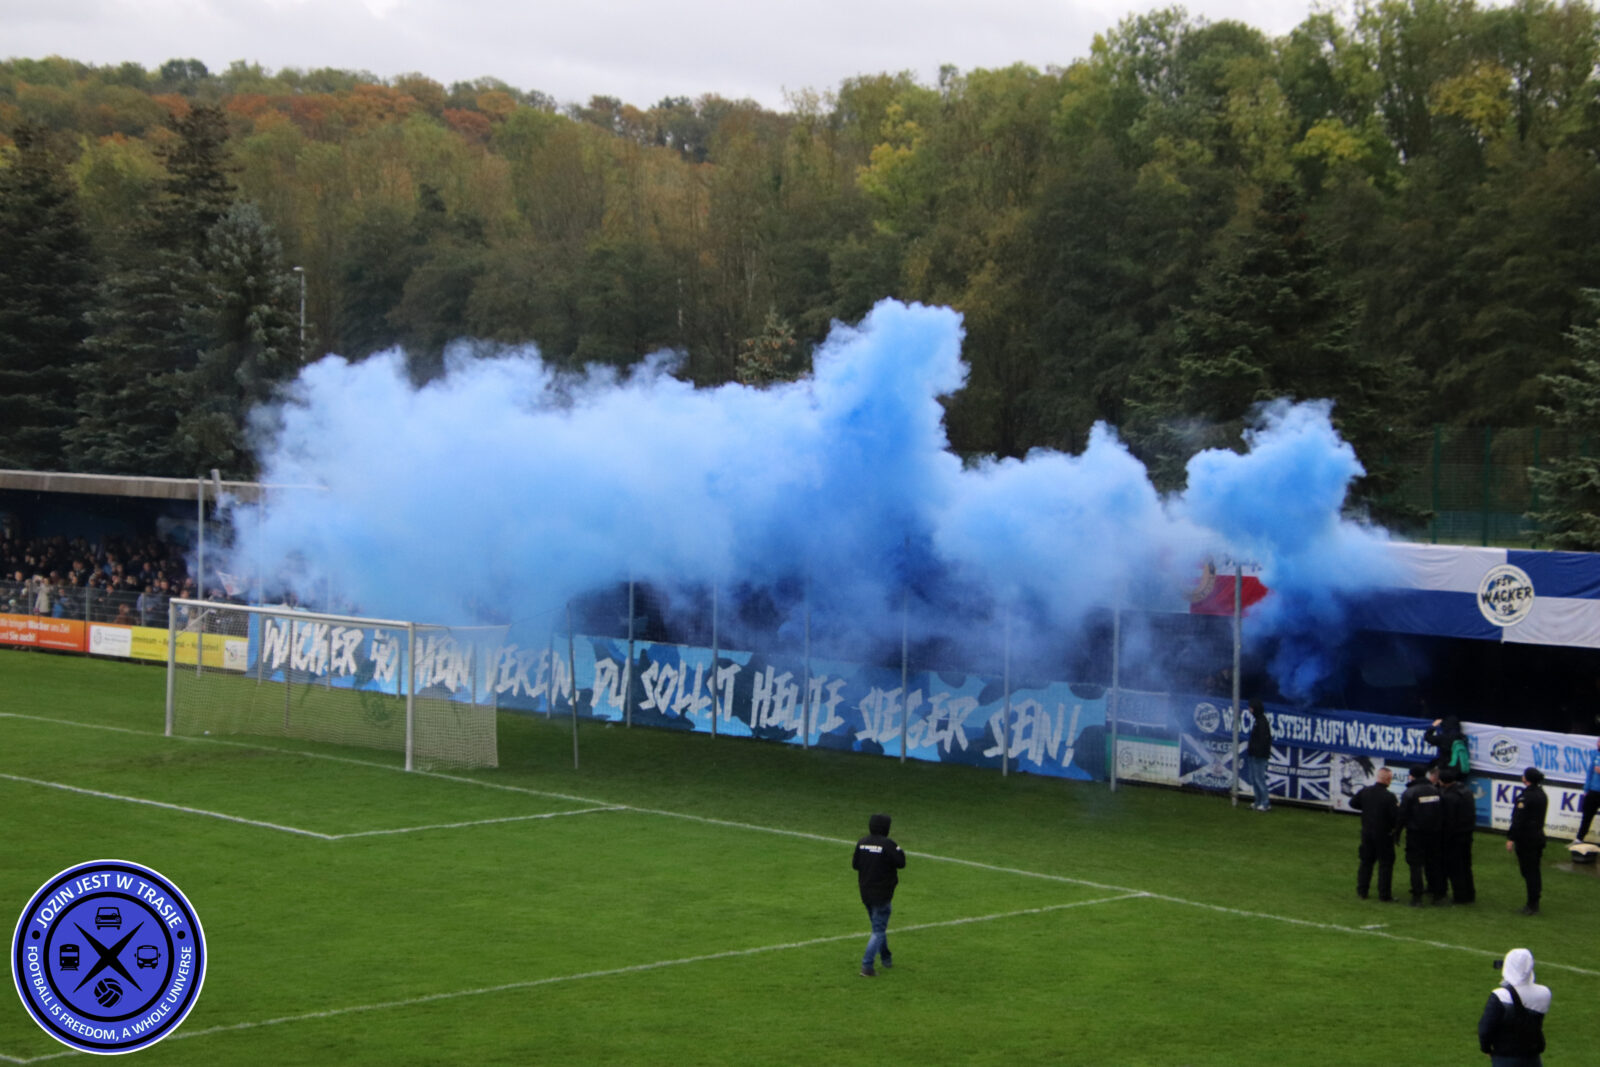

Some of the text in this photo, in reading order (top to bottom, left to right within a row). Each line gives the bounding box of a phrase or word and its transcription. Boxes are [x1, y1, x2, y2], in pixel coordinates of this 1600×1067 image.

[1481, 586, 1532, 604] WACKER
[263, 619, 364, 677] WACKER
[639, 660, 741, 722] SOLLST
[751, 664, 847, 737] HEUTE
[855, 686, 979, 753] SIEGER
[1313, 717, 1344, 745] AUF!
[1531, 741, 1593, 773] WIR SIN
